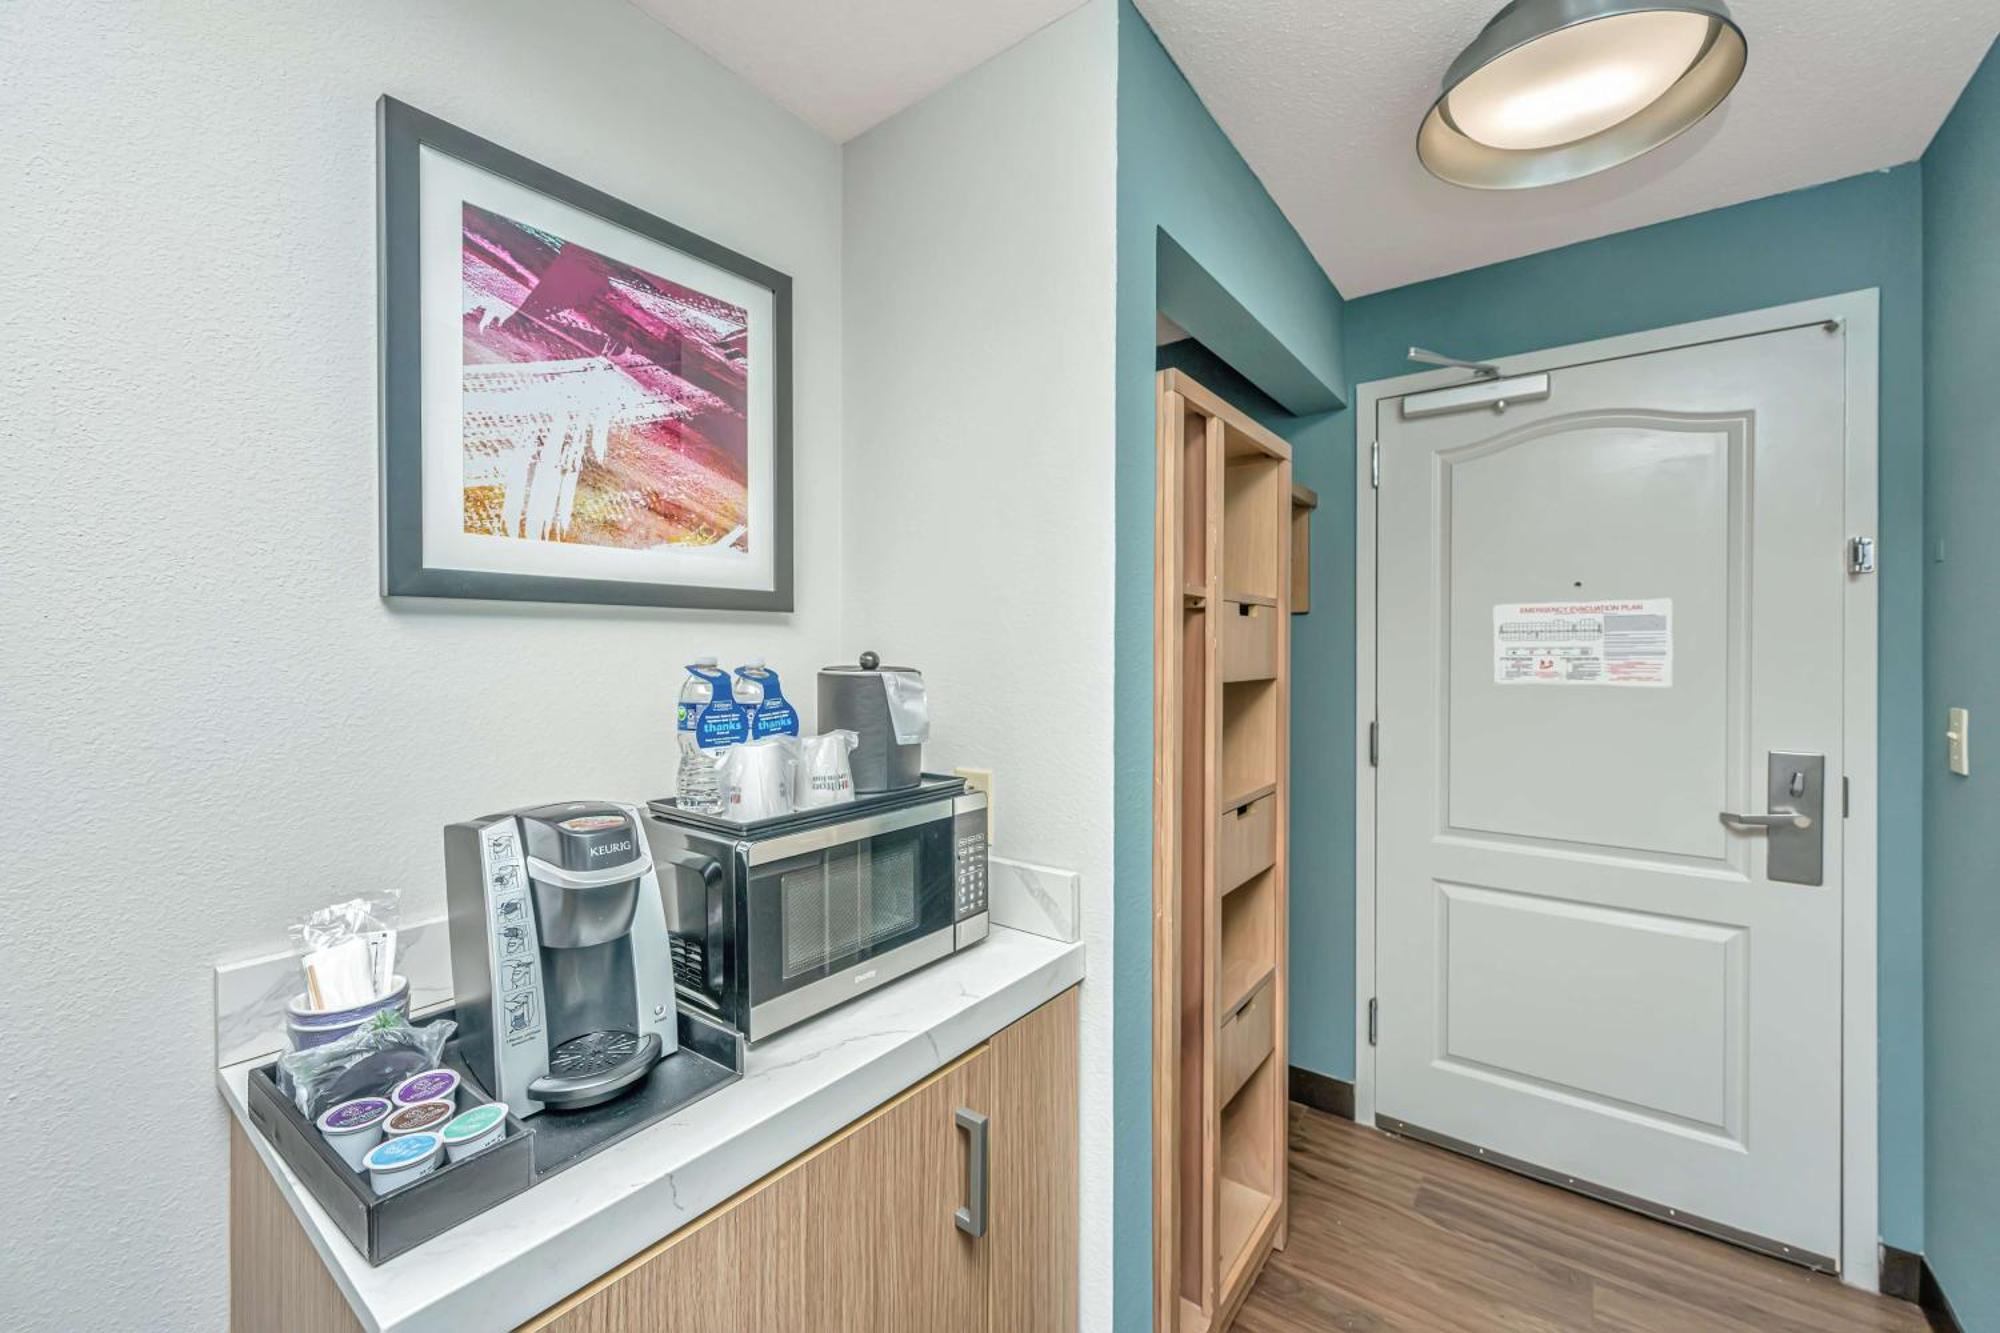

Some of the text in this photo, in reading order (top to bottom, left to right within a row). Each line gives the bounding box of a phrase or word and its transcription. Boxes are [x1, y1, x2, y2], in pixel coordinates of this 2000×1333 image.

[1569, 604, 1619, 613] EVACUATION
[1621, 603, 1644, 611] PLAN
[703, 721, 742, 732] thanks
[758, 717, 792, 730] thanks
[590, 840, 632, 857] KEURIG
